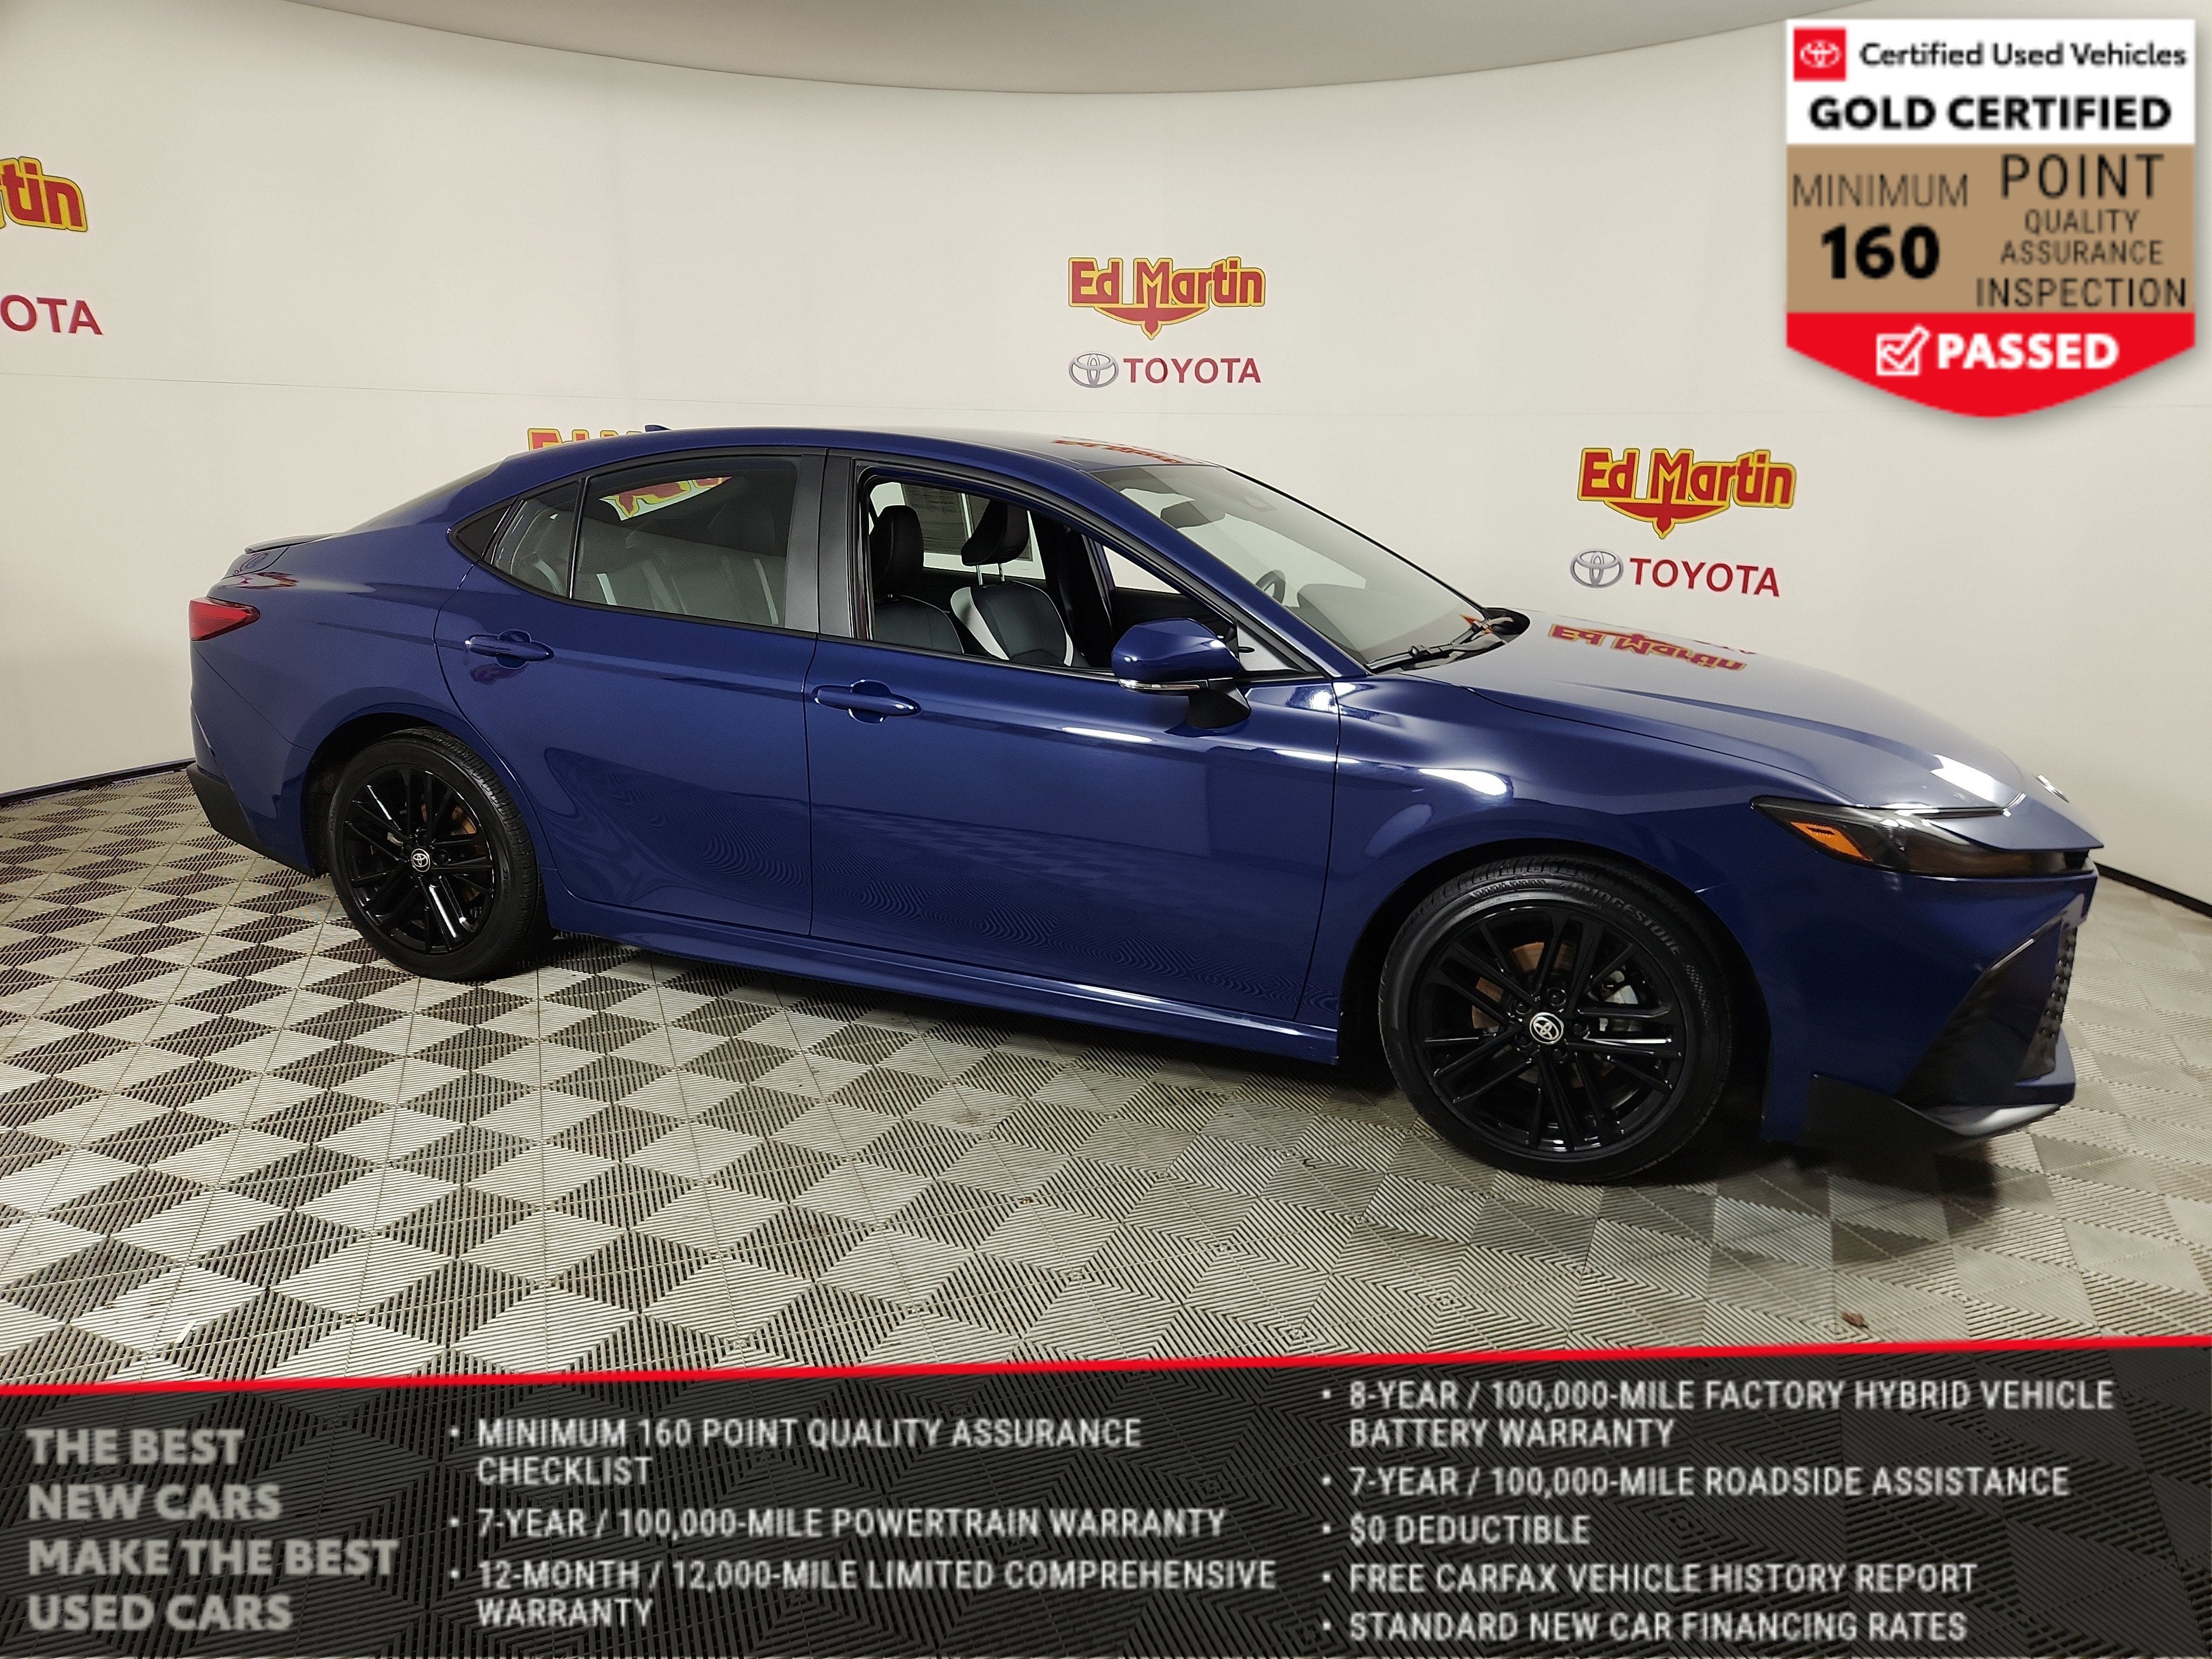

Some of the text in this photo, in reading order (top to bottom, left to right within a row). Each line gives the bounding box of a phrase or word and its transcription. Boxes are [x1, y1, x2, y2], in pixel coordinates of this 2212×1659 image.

[0, 156, 88, 232] tin
[1069, 257, 1266, 307] Ed Martin
[1123, 357, 1262, 384] TOYOTA
[1577, 448, 1797, 509] Ed Martin
[1629, 557, 1780, 597] TOYOTA
